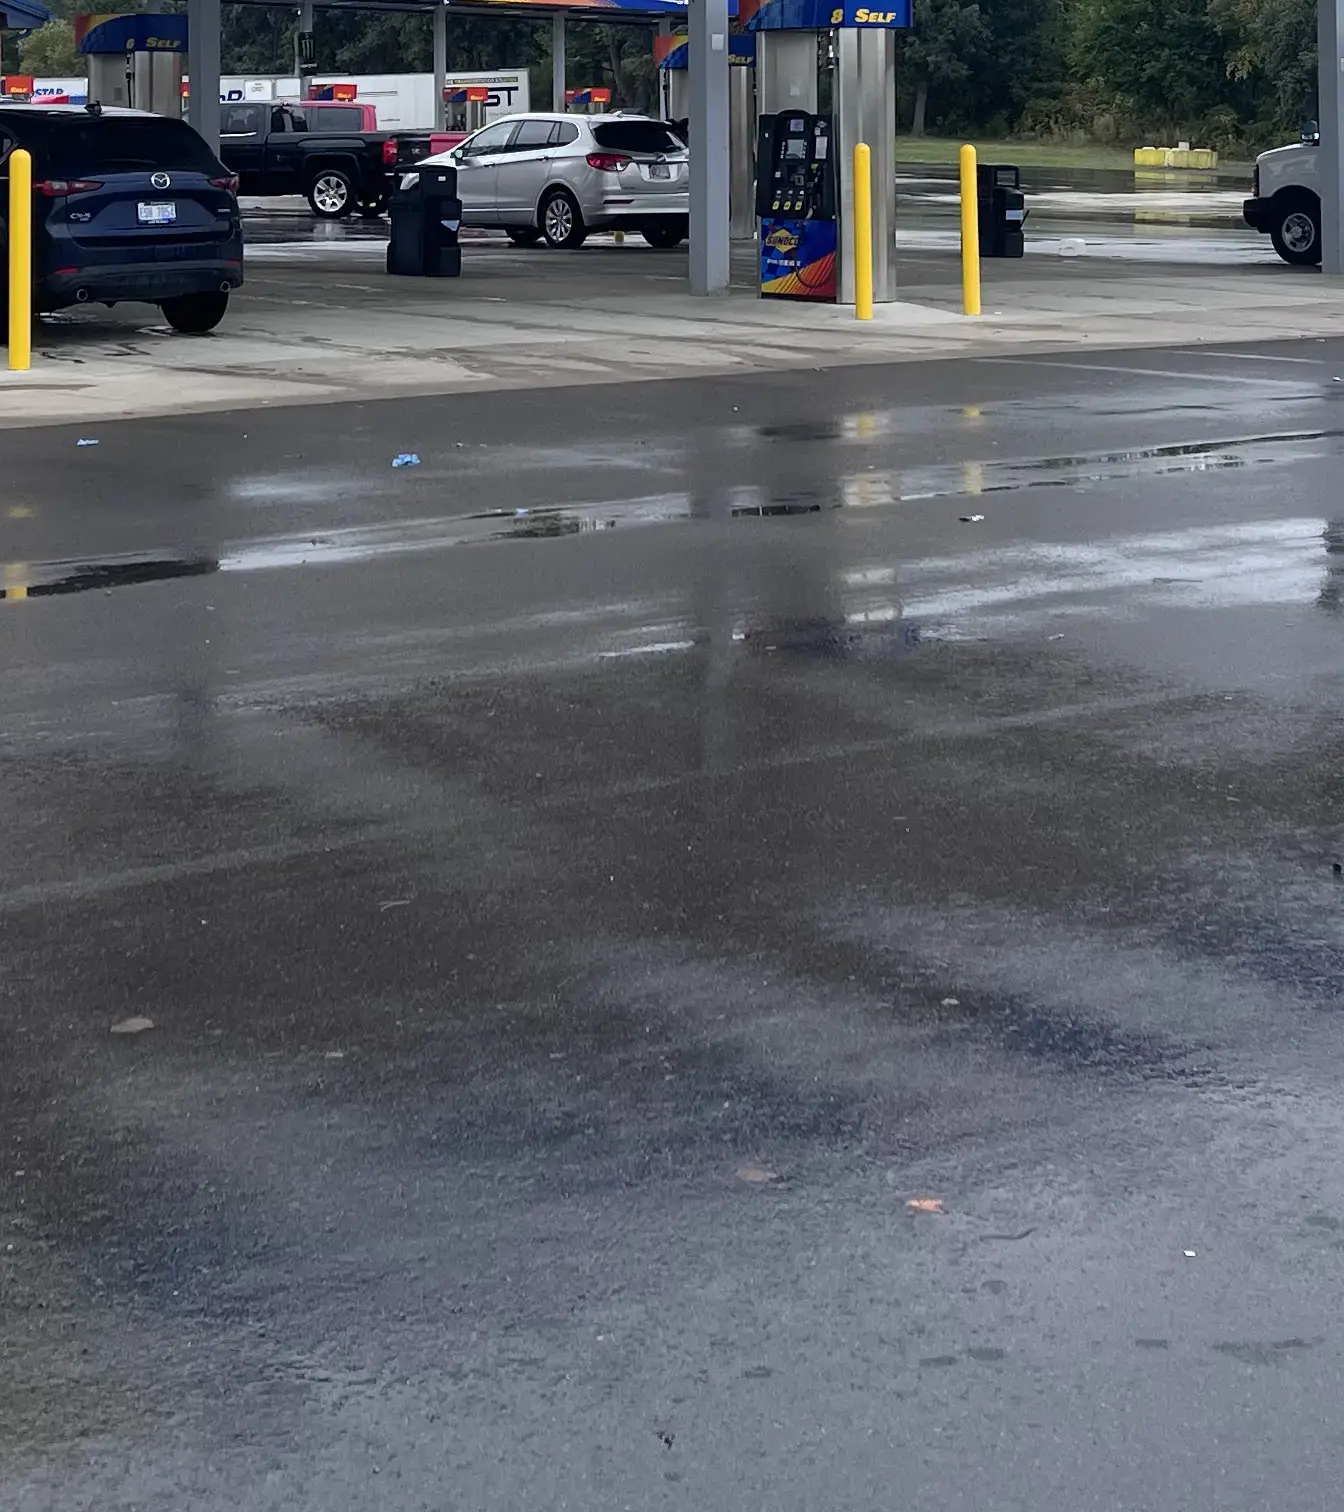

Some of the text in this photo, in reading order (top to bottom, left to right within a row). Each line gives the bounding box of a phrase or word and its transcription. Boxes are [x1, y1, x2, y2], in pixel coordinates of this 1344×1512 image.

[830, 8, 844, 24] 8
[854, 8, 897, 23] SELF
[145, 37, 182, 48] SELF
